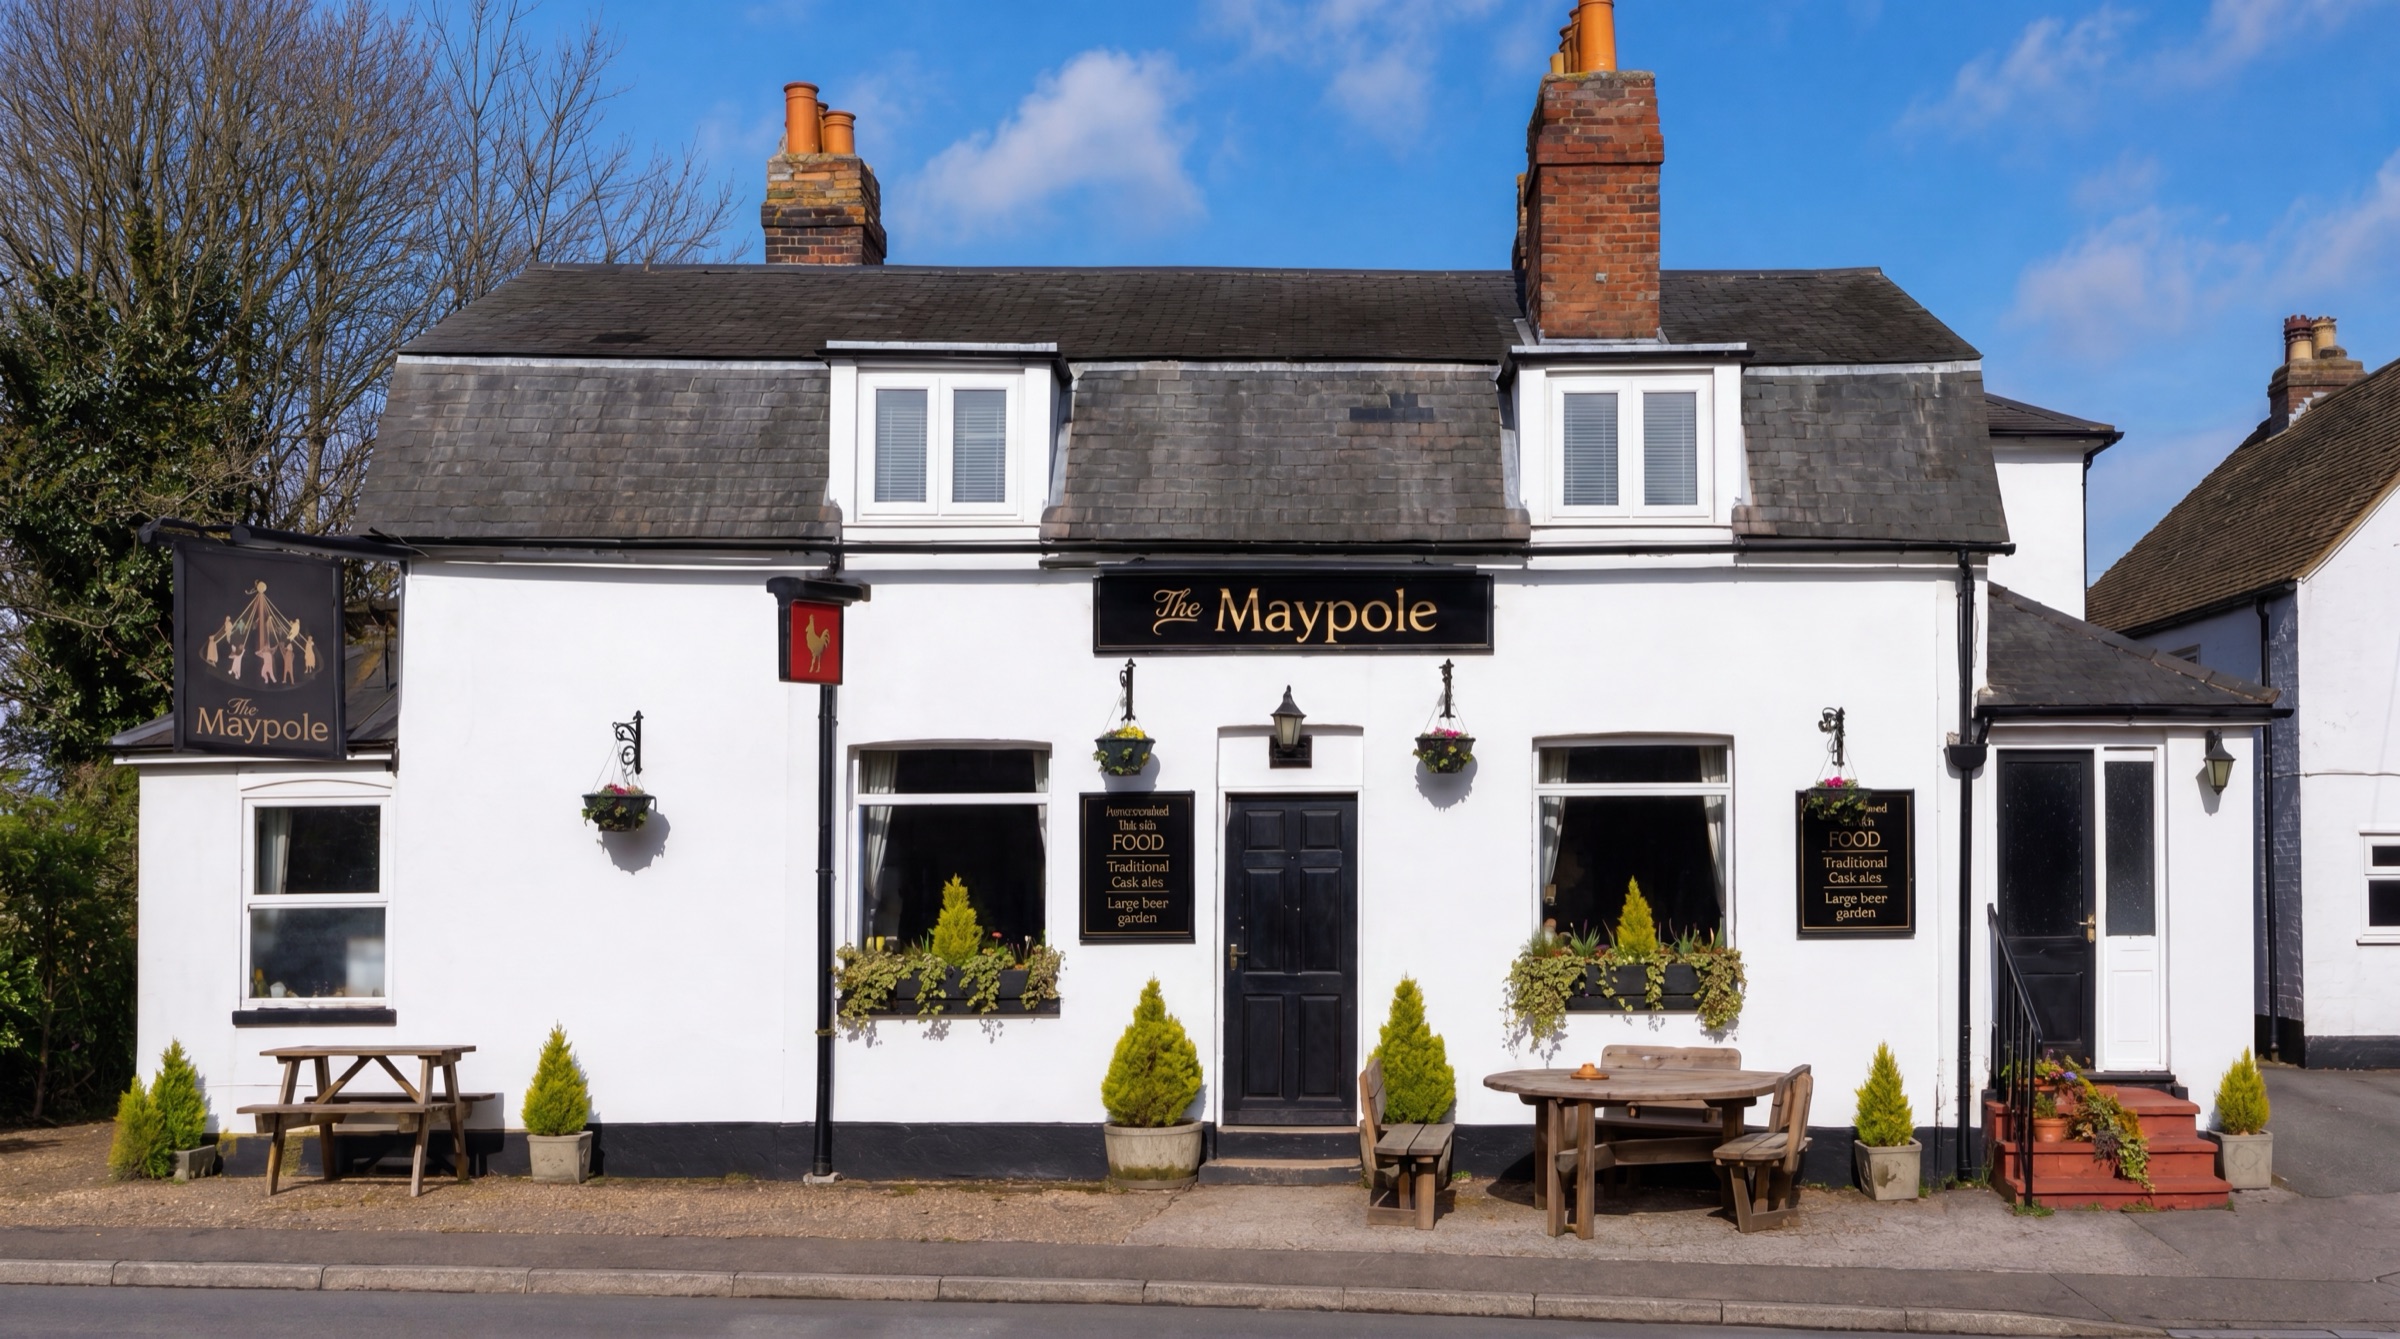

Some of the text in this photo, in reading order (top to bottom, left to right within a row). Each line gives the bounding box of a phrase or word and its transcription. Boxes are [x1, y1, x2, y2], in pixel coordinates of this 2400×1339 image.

[1153, 588, 1437, 643] The Maypole
[227, 698, 258, 716] The
[196, 707, 329, 745] Maypole
[1112, 834, 1165, 851] FOOD
[1830, 831, 1881, 848] FOOD
[1106, 860, 1170, 873] Traditional
[1823, 856, 1888, 869] Traditional
[1112, 876, 1164, 888] Cask ales
[1828, 872, 1882, 884] Cask ales
[1108, 897, 1169, 912] Large beer
[1825, 892, 1888, 907] Large beer
[1117, 911, 1158, 928] garden
[1836, 907, 1876, 922] garden
